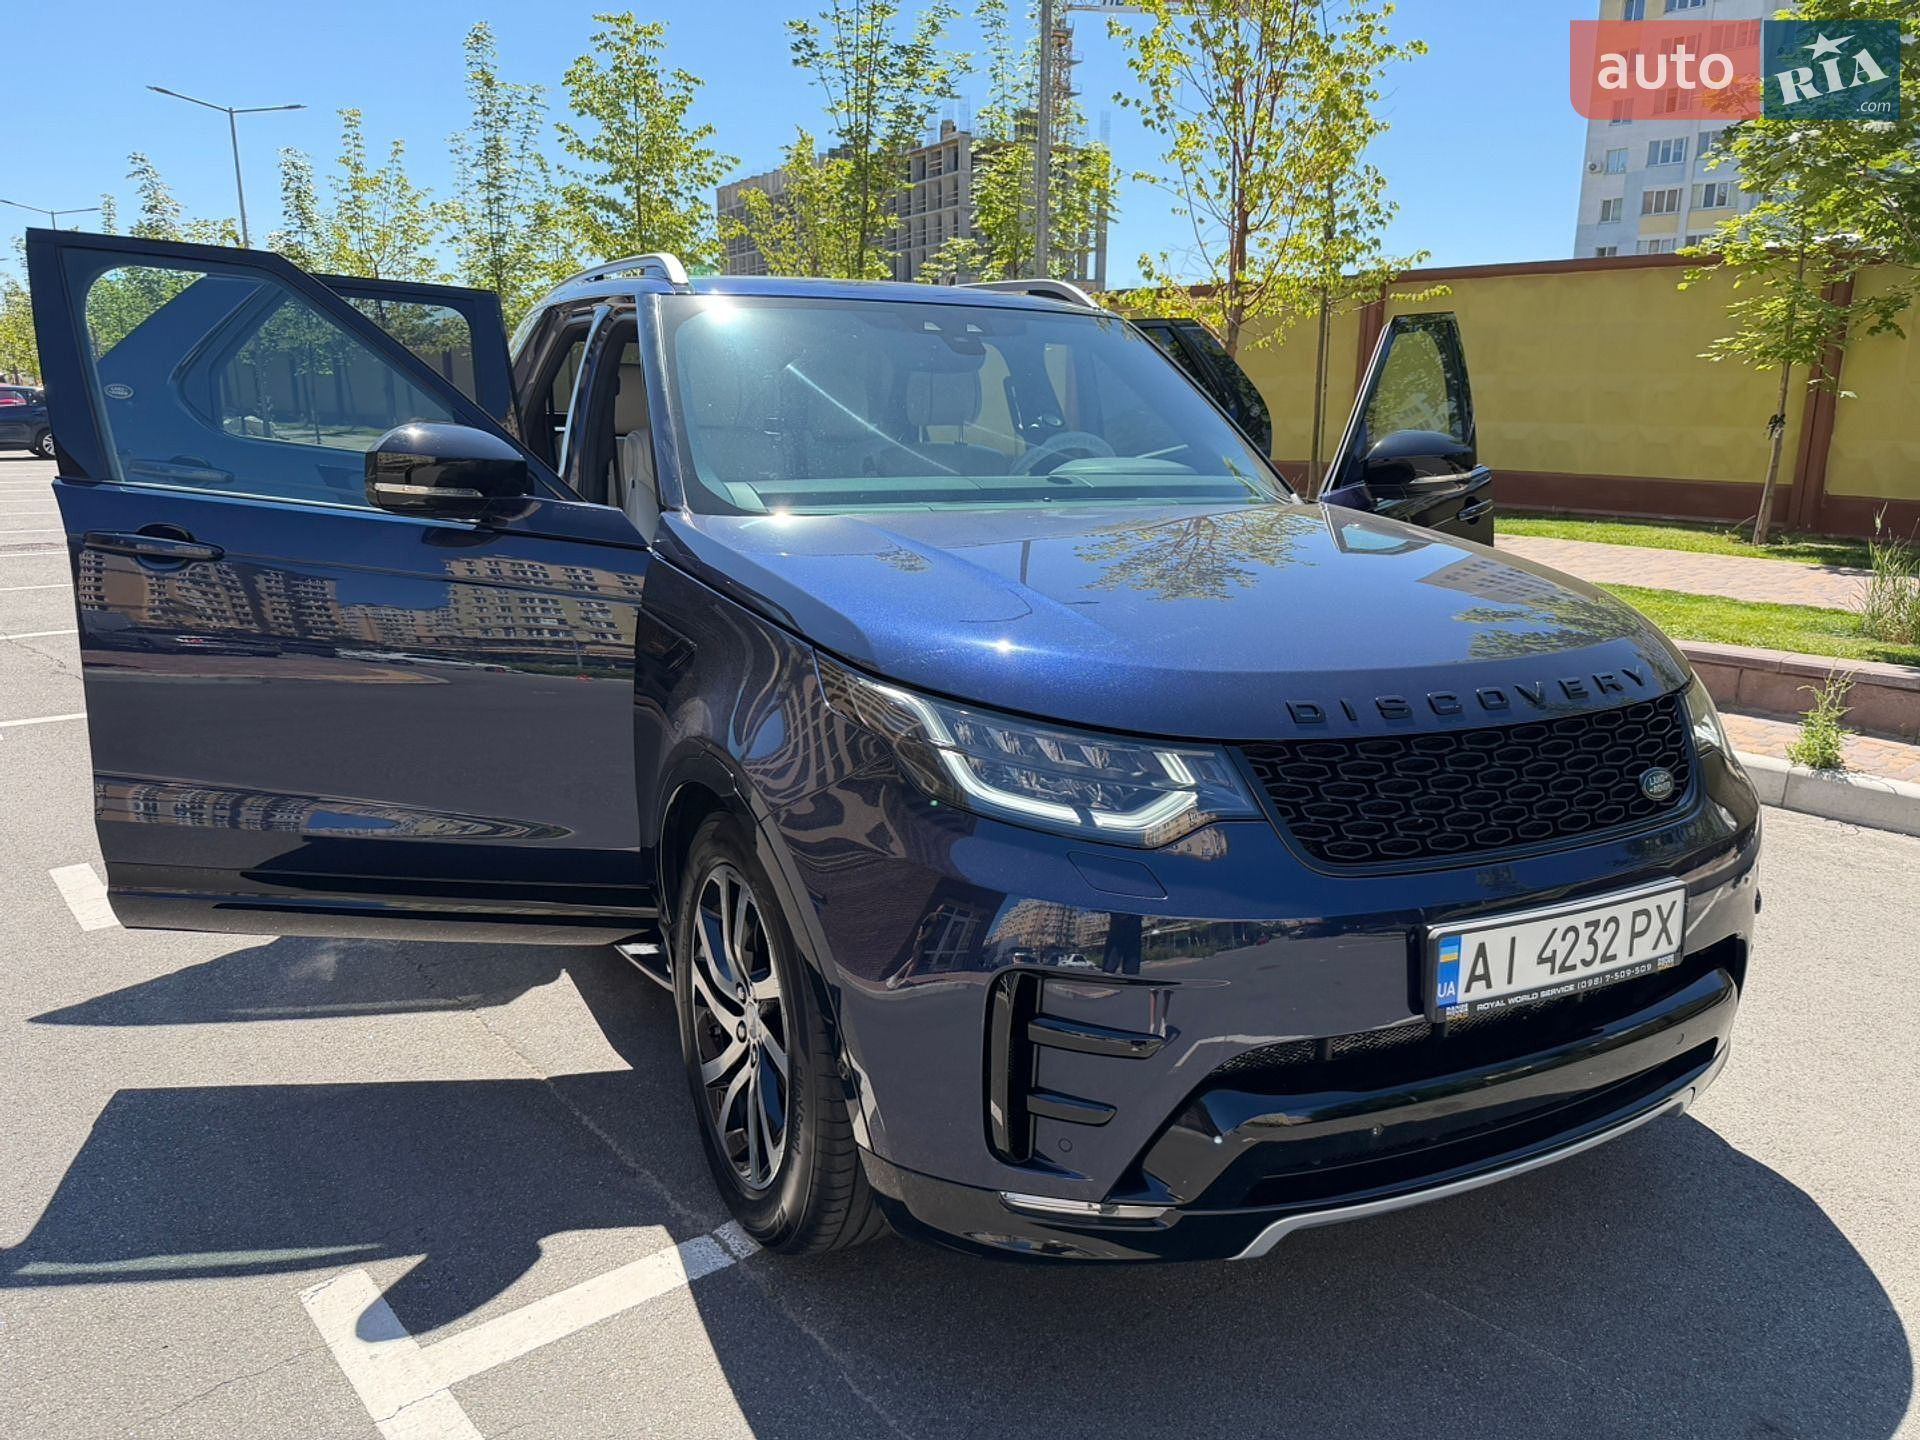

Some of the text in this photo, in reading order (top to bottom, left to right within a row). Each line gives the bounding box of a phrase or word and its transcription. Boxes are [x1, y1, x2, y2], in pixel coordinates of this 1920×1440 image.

[1286, 666, 1646, 724] DISCOVERY
[1464, 900, 1677, 993] AI 4232 PX
[1437, 981, 1456, 998] UA
[1477, 1000, 1505, 1012] ROYAL
[1507, 992, 1538, 1005] WORLD
[1540, 984, 1575, 998] SERVICE
[1577, 976, 1603, 990] (098)
